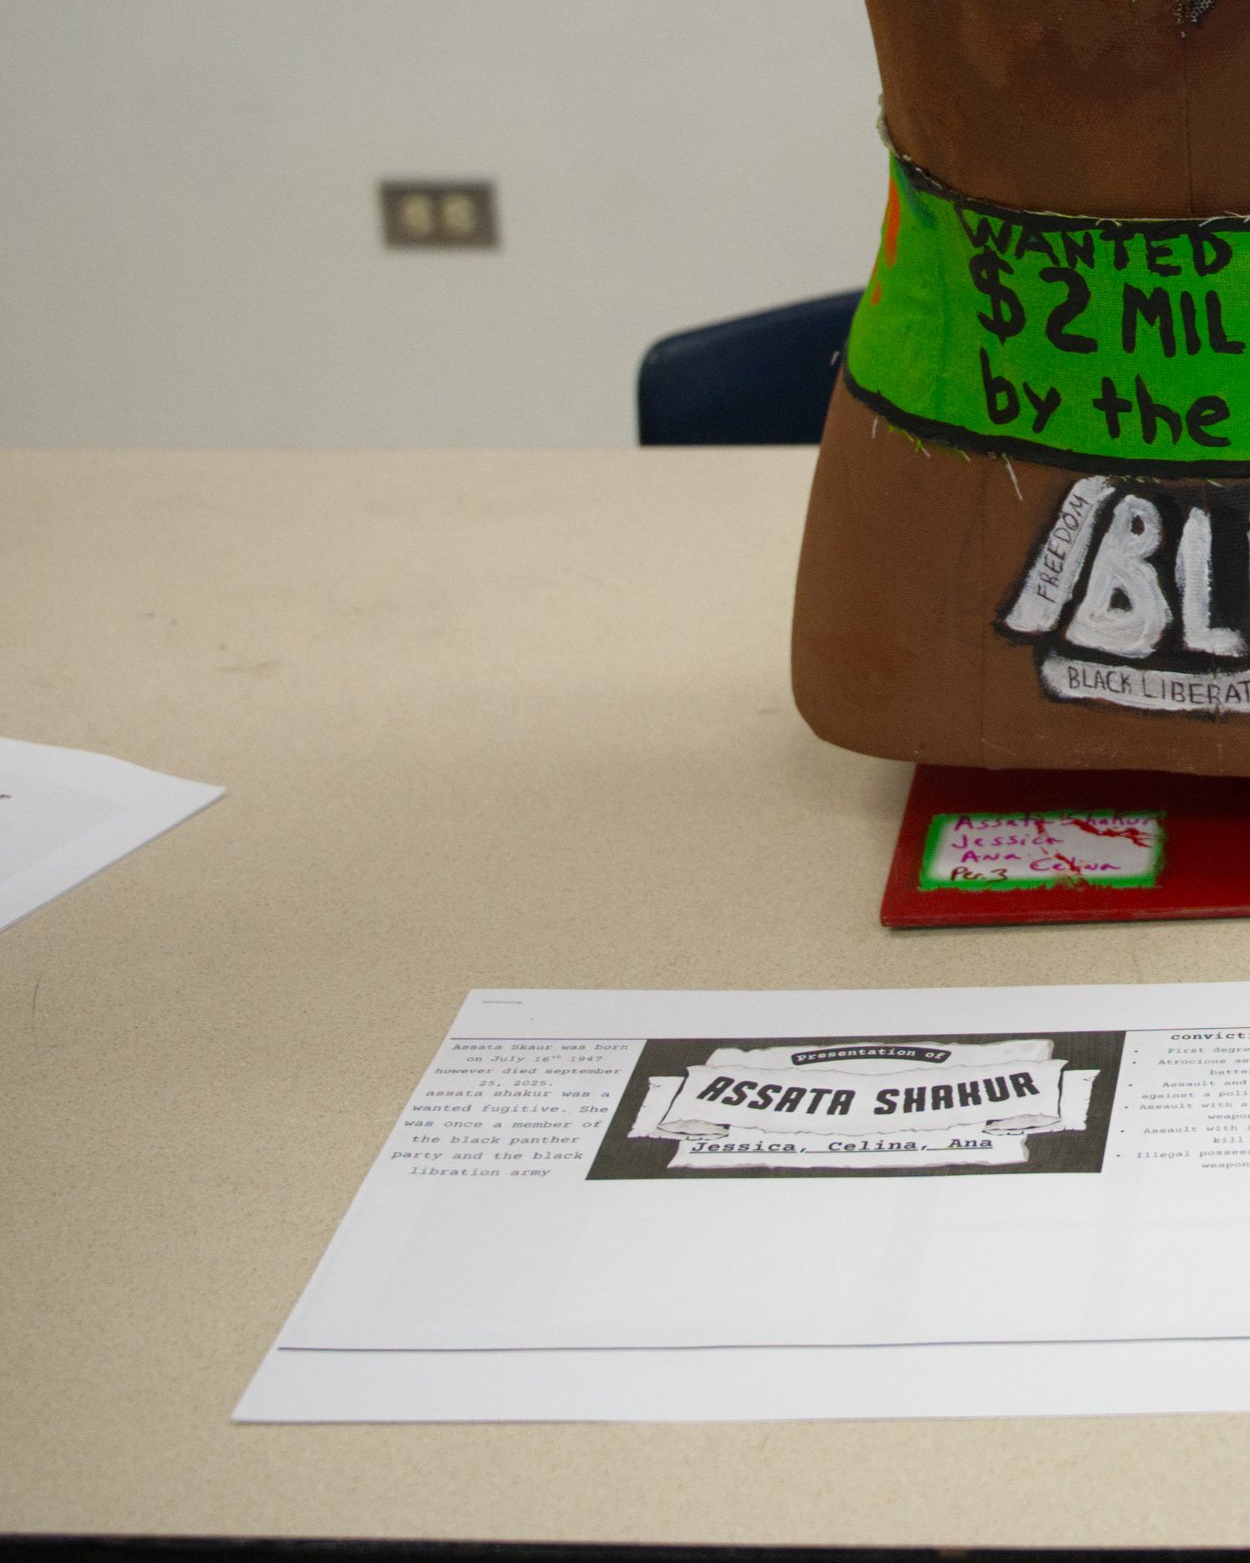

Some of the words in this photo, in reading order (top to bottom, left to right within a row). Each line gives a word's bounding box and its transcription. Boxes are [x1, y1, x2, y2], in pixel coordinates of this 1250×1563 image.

[963, 216, 1233, 276] WANTED
[979, 346, 1062, 435] by
[1093, 374, 1232, 448] the
[1036, 494, 1090, 604] FREEDOM
[1068, 666, 1131, 692] BLACK
[951, 834, 1064, 849] Jessica
[984, 868, 1008, 882] 3
[451, 1043, 503, 1051] Assata
[594, 1043, 629, 1051] born
[925, 1050, 947, 1062] of
[434, 1067, 495, 1075] however
[501, 1067, 538, 1075] died
[544, 1067, 622, 1076] september
[425, 1089, 484, 1098] assata
[491, 1089, 553, 1098] shakur
[561, 1090, 592, 1098] was
[696, 1076, 856, 1115] ASSATA
[873, 1072, 1040, 1115] SHAKUR
[412, 1104, 473, 1113] wanted
[481, 1104, 567, 1115] fugitive.
[578, 1104, 609, 1114] She
[404, 1120, 435, 1128] was
[443, 1120, 484, 1129] once
[492, 1121, 503, 1129] a
[511, 1120, 573, 1129] member
[581, 1119, 603, 1128] of
[412, 1134, 442, 1144] the
[447, 1135, 502, 1144] black
[507, 1135, 581, 1147] panther
[693, 1141, 808, 1154] Jessica,
[828, 1139, 929, 1152] Celina,
[949, 1137, 993, 1149] Ana
[390, 1151, 444, 1162] party
[451, 1151, 484, 1160] and
[493, 1151, 524, 1161] the
[531, 1150, 584, 1160] black
[409, 1166, 501, 1177] libration
[509, 1169, 552, 1178] army
